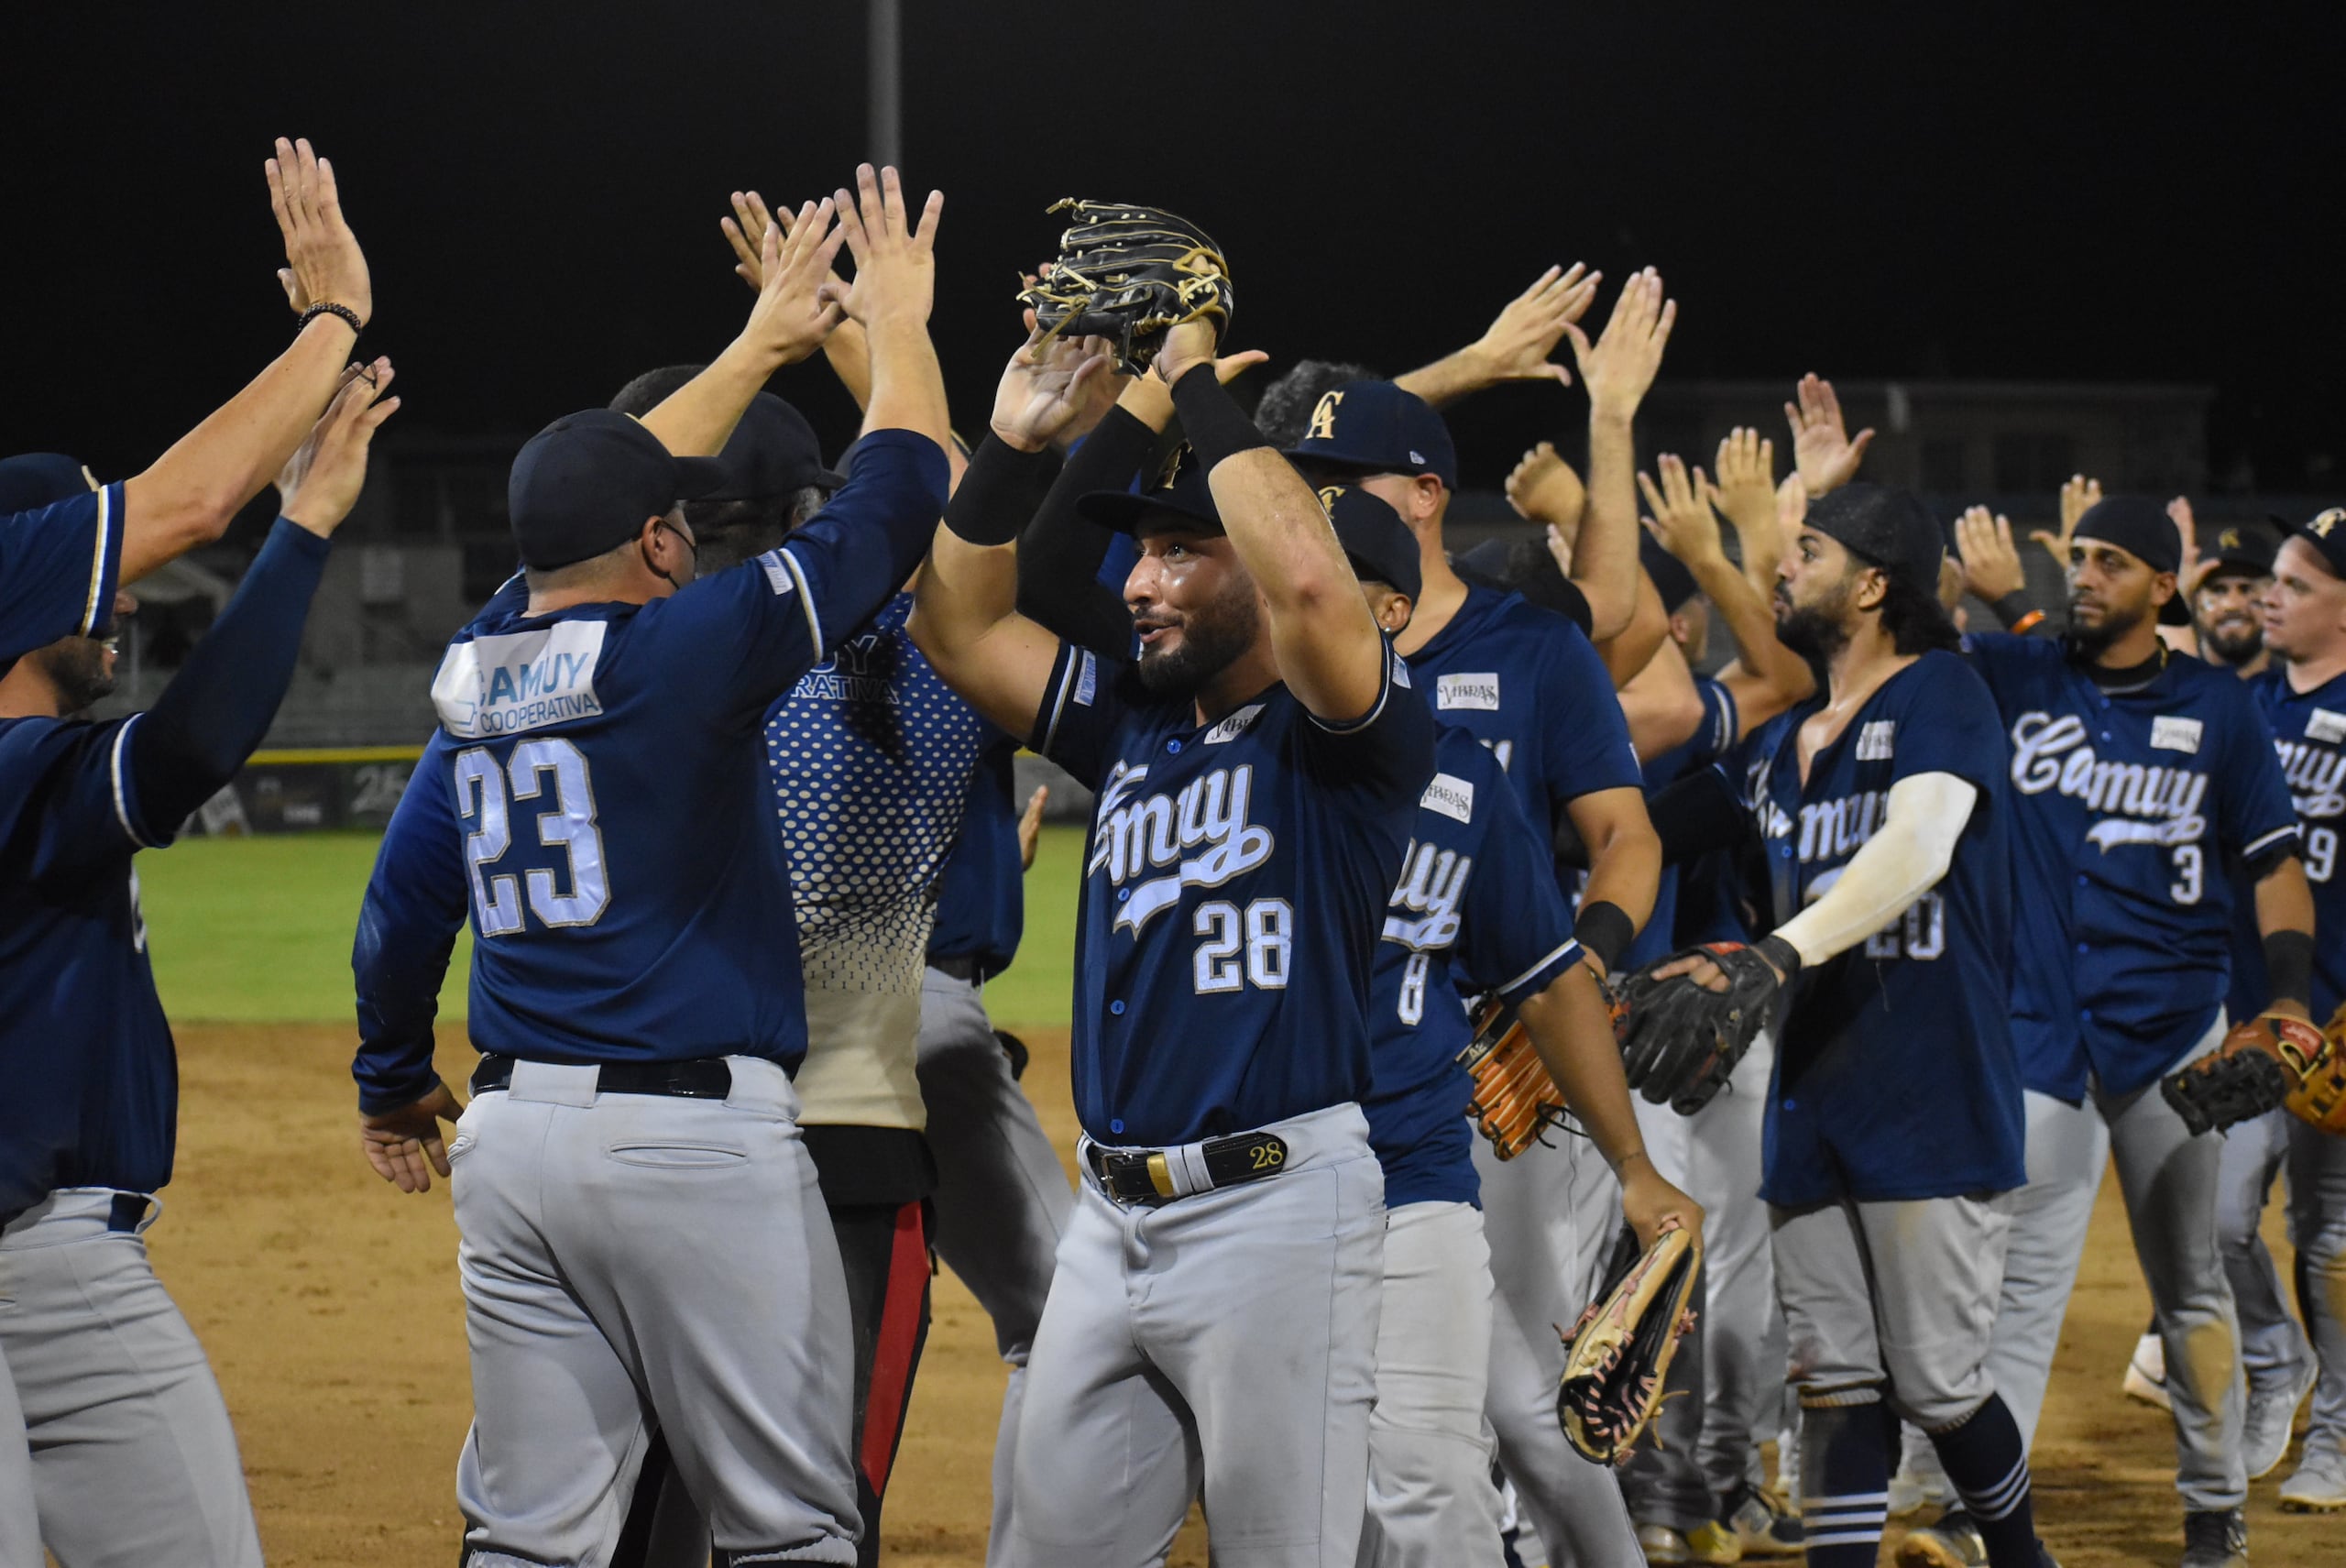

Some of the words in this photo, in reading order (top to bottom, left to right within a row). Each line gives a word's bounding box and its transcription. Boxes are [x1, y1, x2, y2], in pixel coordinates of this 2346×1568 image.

[480, 693, 599, 733] COOPERATIVA
[2012, 717, 2209, 857] Camuy
[455, 738, 611, 938] 23
[2169, 844, 2203, 905] 3
[1192, 897, 1294, 994] 28
[1398, 952, 1430, 1025] 8
[1249, 1141, 1283, 1169] 28
